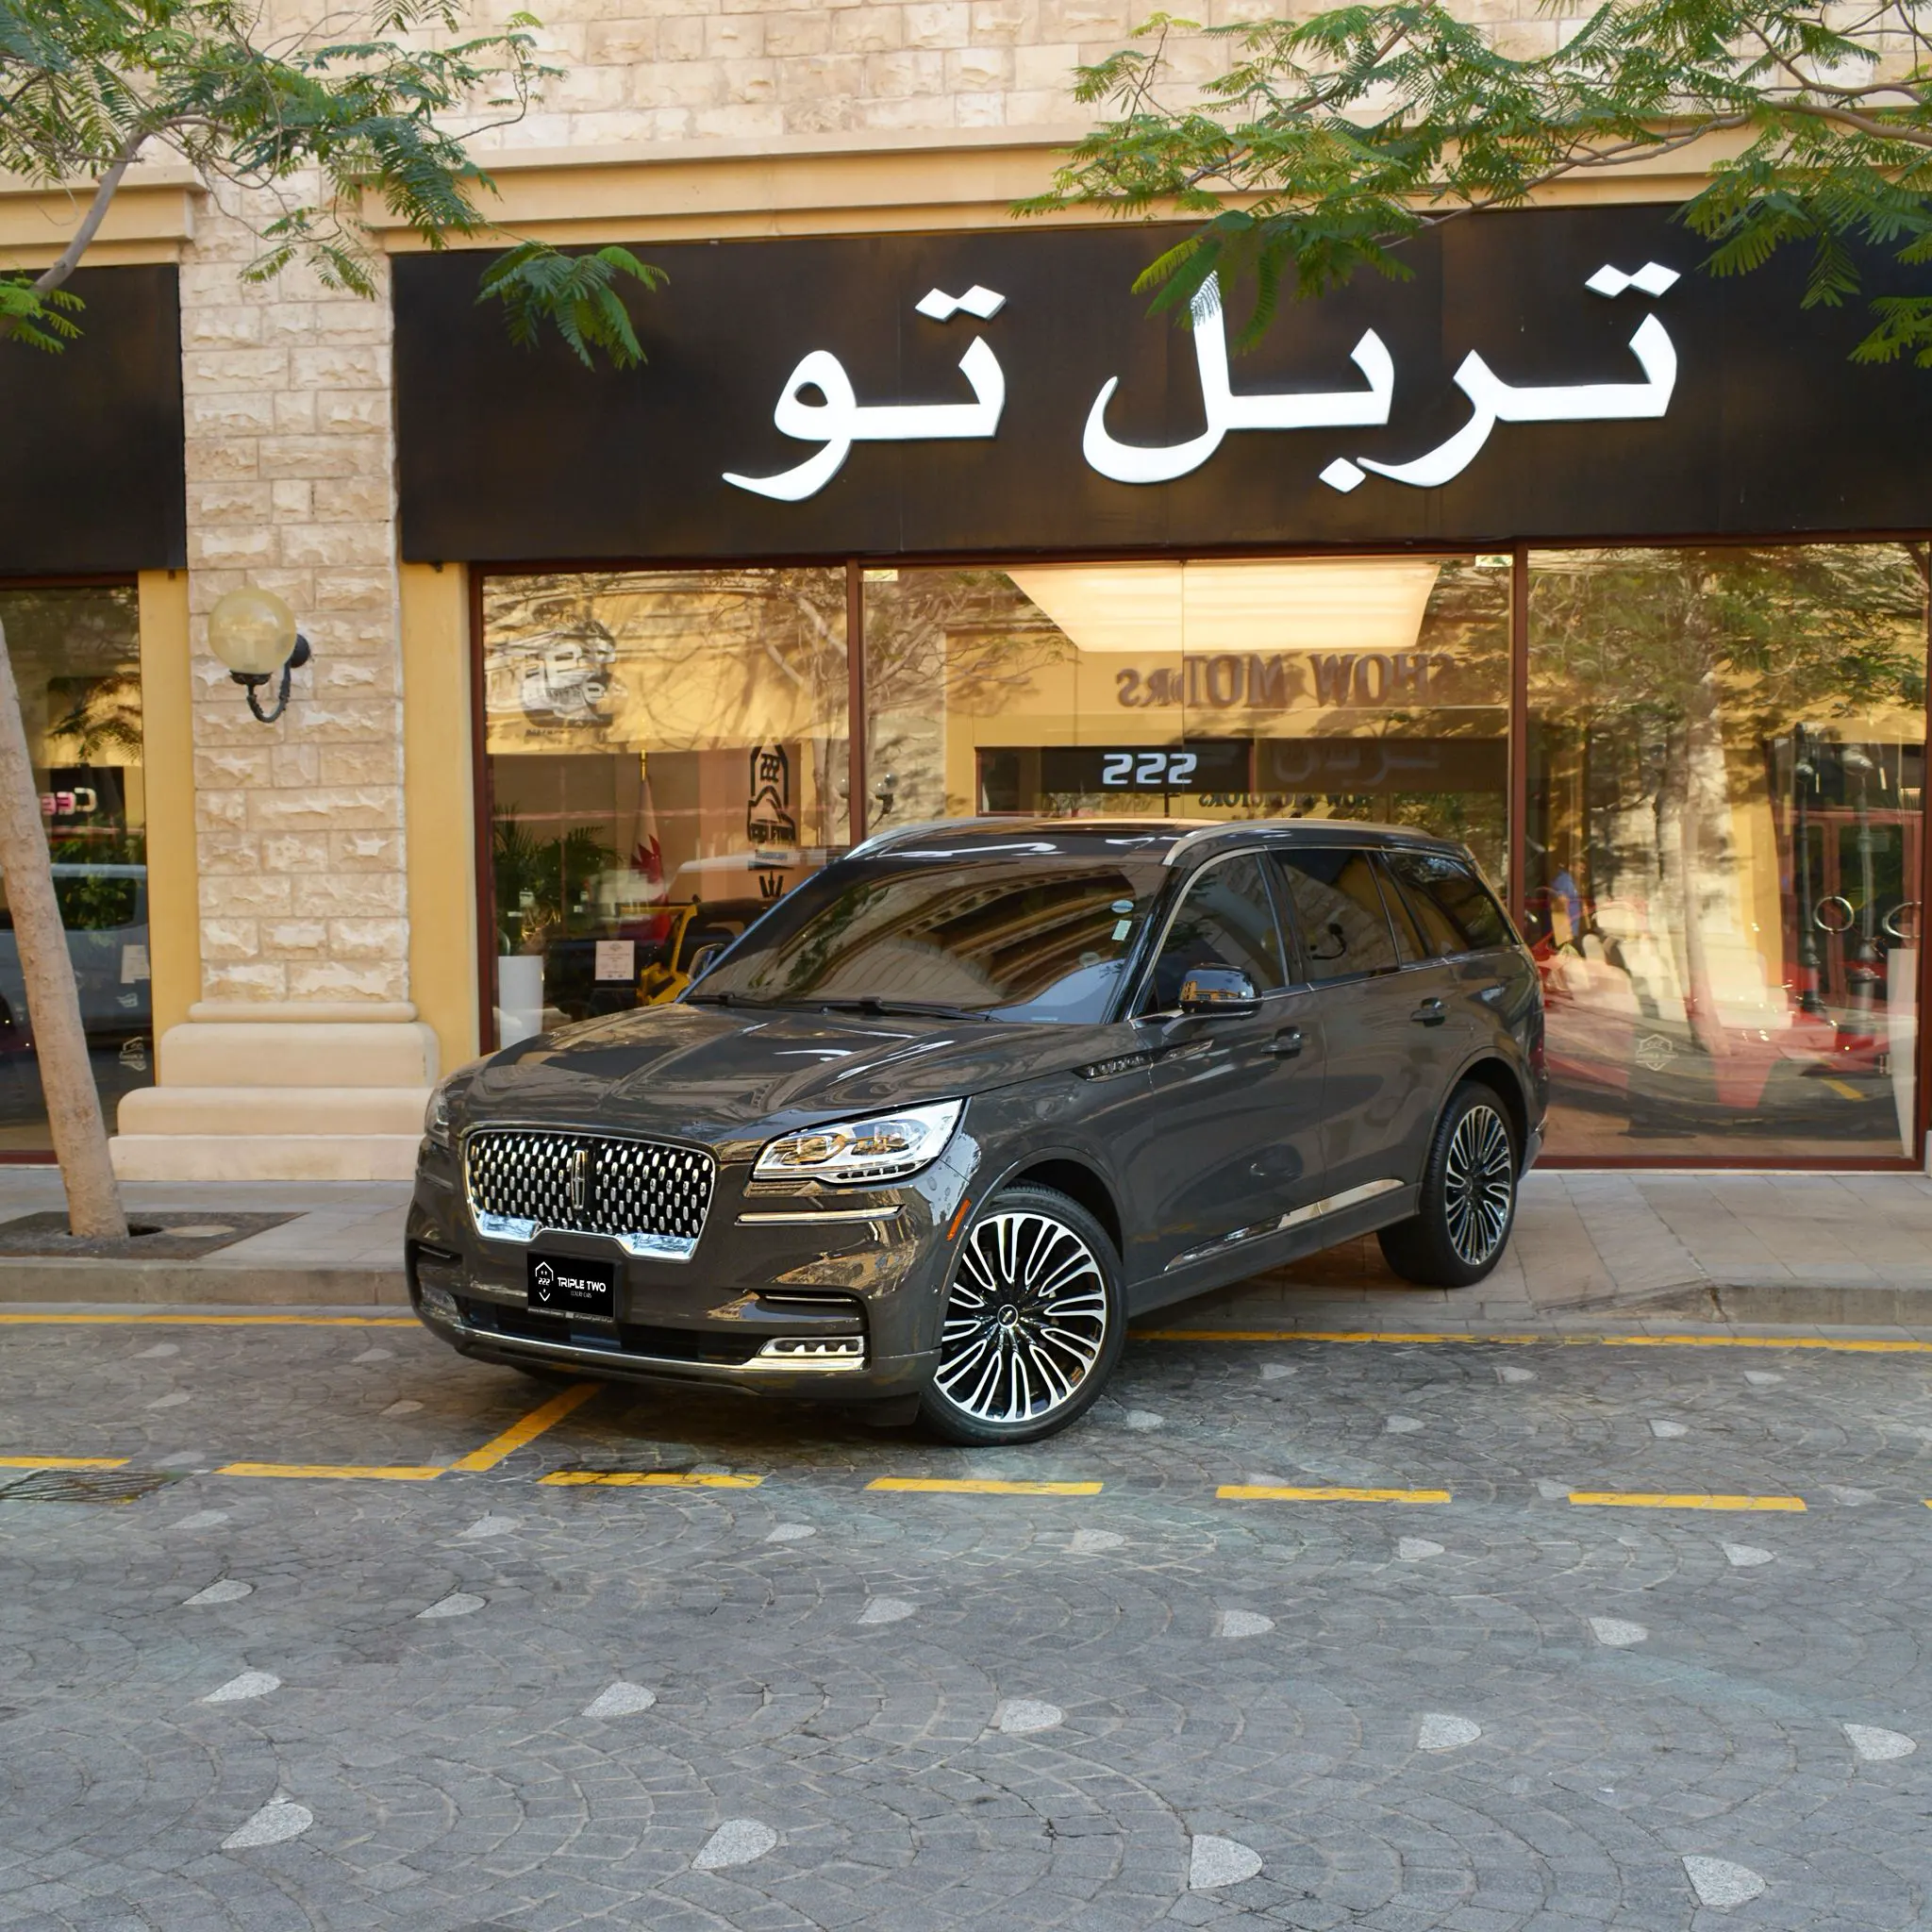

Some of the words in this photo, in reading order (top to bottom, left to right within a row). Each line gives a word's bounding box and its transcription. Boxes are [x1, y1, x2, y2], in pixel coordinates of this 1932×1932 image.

[721, 283, 1007, 503] تو
[538, 1276, 551, 1286] 222
[557, 1276, 585, 1290] TRIPLE
[586, 1280, 607, 1292] TWO
